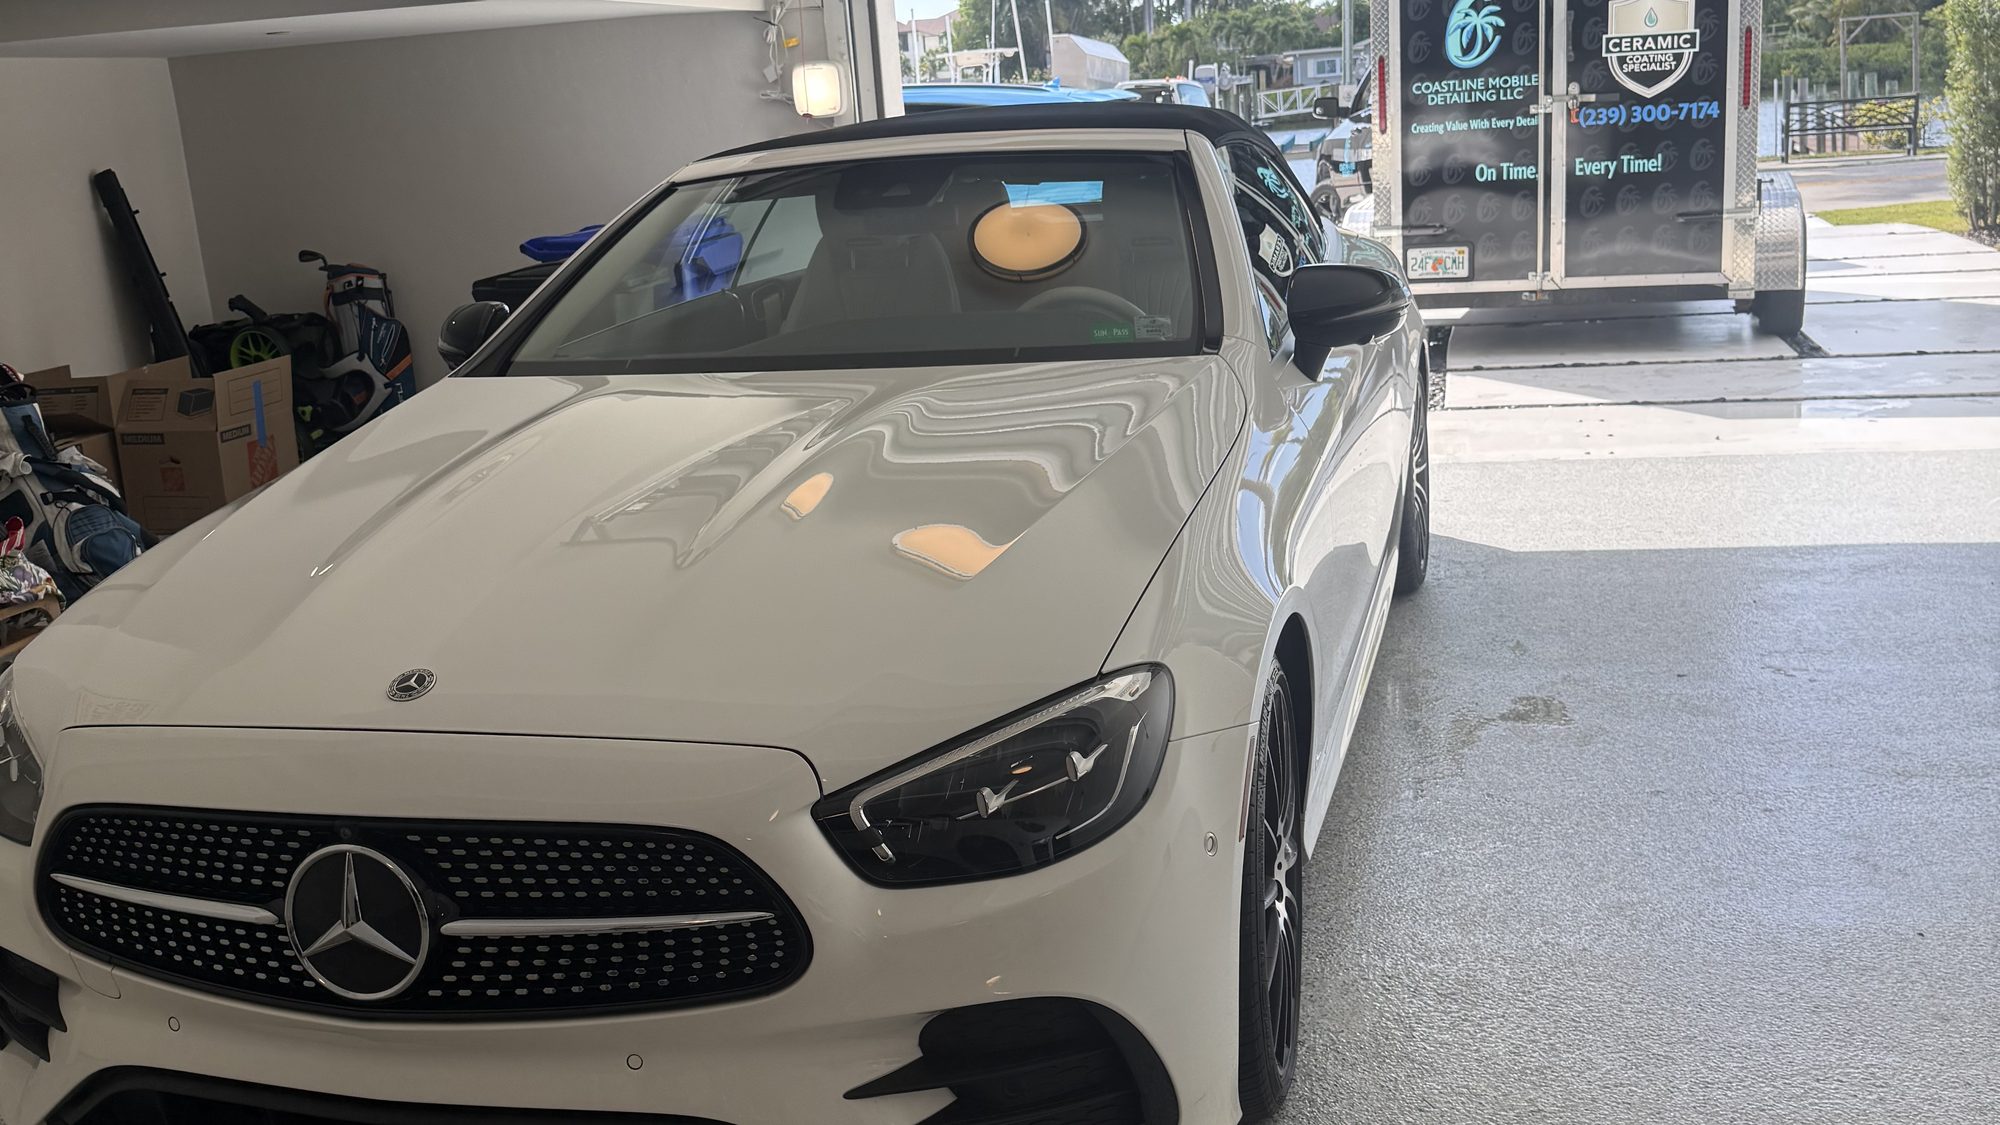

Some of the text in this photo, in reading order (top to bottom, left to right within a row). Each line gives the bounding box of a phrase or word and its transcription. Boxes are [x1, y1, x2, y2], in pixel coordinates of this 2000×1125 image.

[1608, 34, 1691, 52] CERAMIC
[1622, 61, 1677, 73] SPECIALIST
[1626, 53, 1674, 64] COATING
[1412, 74, 1539, 94] COASTLINE MOBILE
[1427, 88, 1524, 106] DETAILING LLC
[1578, 101, 1720, 128] (239) 300-7174
[1411, 115, 1539, 135] Creating Value With Every Detai
[1475, 163, 1497, 182] On
[1575, 153, 1663, 180] Every Time!
[123, 435, 163, 444] MEDIUM
[222, 426, 250, 441] MEDIUM
